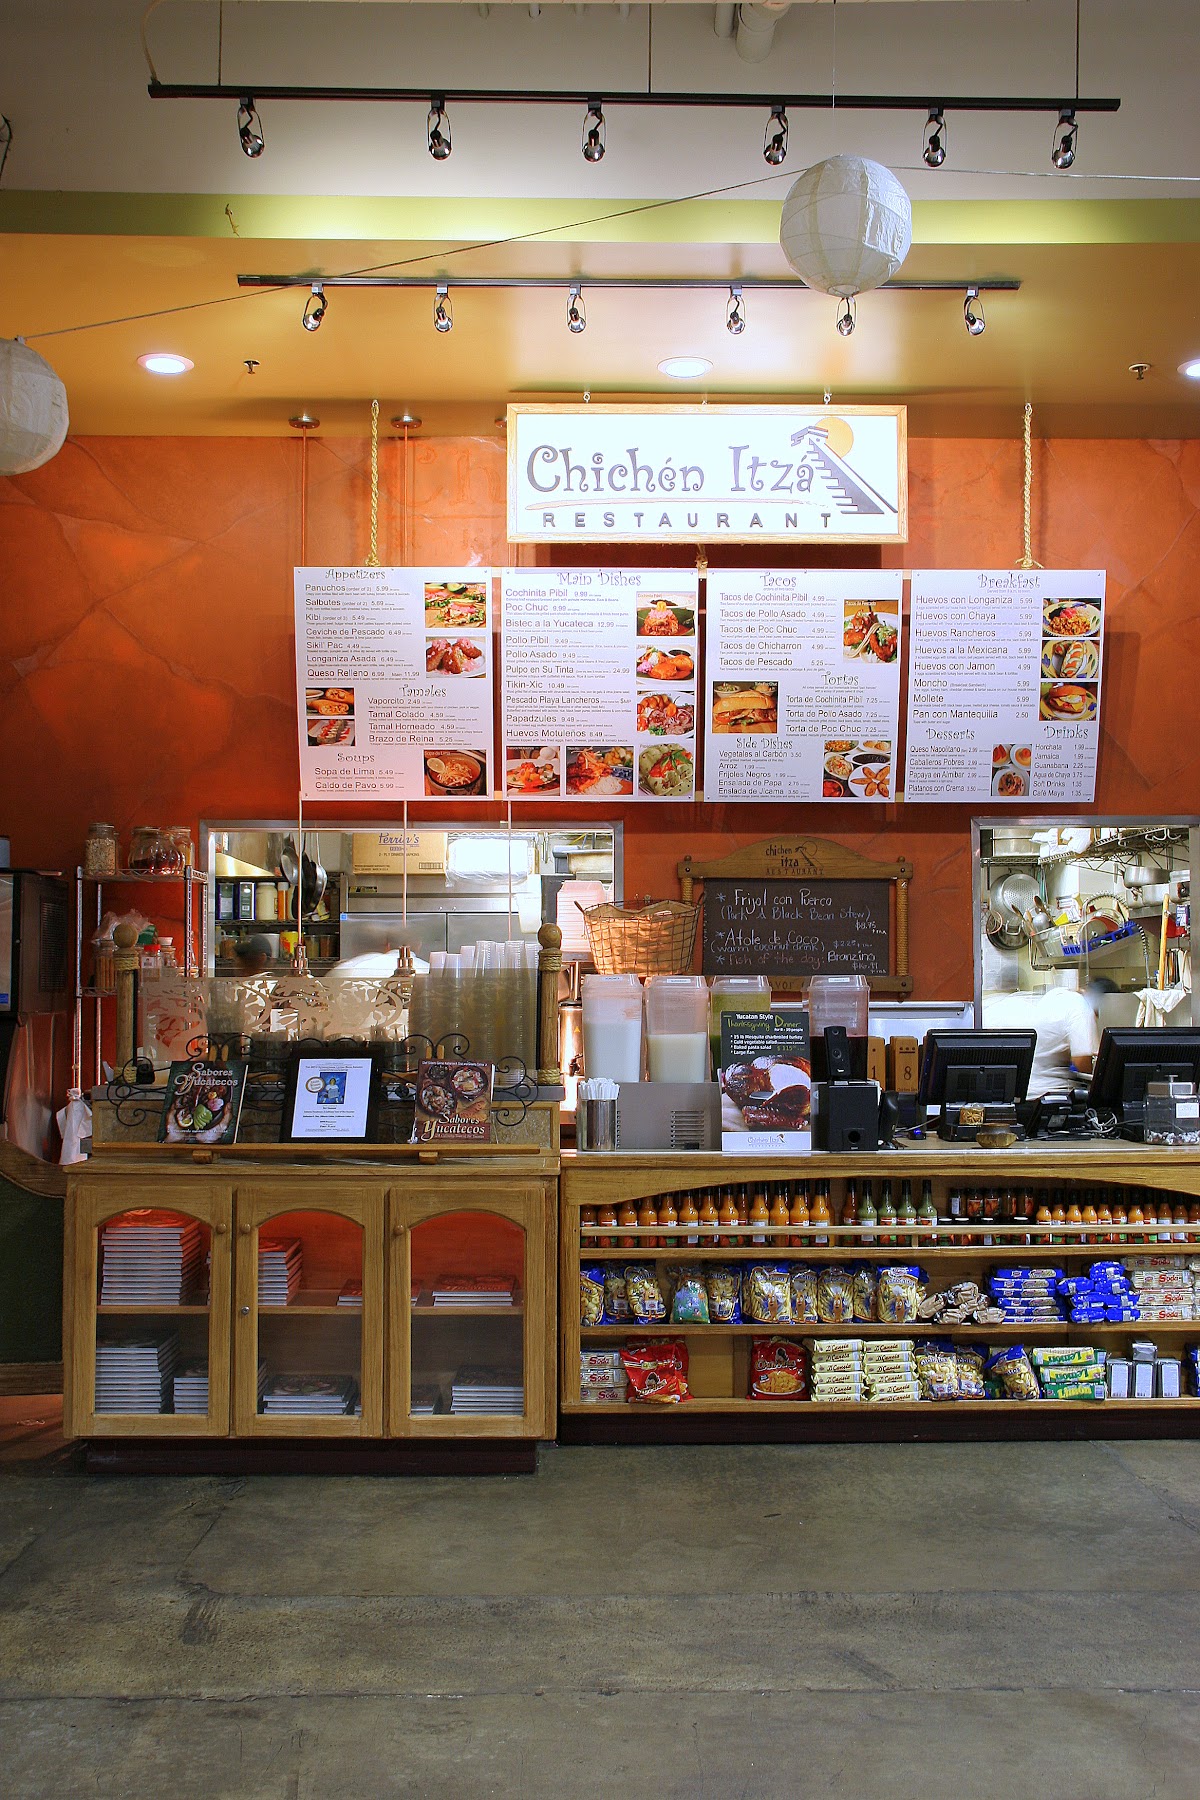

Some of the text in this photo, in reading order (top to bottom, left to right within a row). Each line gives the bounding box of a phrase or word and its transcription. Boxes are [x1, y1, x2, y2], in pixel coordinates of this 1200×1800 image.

[527, 445, 814, 494] Chichén Itzá
[542, 512, 832, 528] RESTAURANT
[325, 569, 386, 581] Appetizers
[557, 572, 640, 586] Main Dishes
[759, 572, 797, 587] Tacos
[978, 573, 1041, 589] Breakfast
[505, 589, 568, 597] Cochinita Pibil
[305, 598, 341, 606] Salbutes
[916, 595, 948, 604] Huevos
[968, 595, 1013, 605] Longaniza
[505, 603, 548, 611] Poc Chuc
[720, 609, 743, 618] Tacos
[745, 609, 756, 618] de
[758, 609, 778, 618] Pollo
[780, 609, 806, 618] Asado
[505, 619, 533, 628] Bistec
[553, 619, 594, 628] Yucateca
[915, 629, 996, 637] Huevos Rancheros
[505, 650, 528, 658] Pollo
[529, 650, 558, 658] Asado
[915, 646, 947, 654] Huevos
[957, 646, 965, 654] la
[968, 646, 1008, 654] Mexicana
[306, 655, 349, 663] Longaniza
[719, 658, 792, 666] Tacos de Pescado
[307, 669, 334, 677] Queso
[505, 666, 528, 674] Pulpo
[821, 671, 859, 686] Tortas
[913, 679, 948, 687] Moncho
[505, 680, 543, 688] Tikin-Xic
[399, 684, 447, 698] Tamales
[368, 697, 404, 705] Vaporcito
[506, 696, 600, 705] Pescado Playa Lancheros
[913, 694, 944, 702] Mollete
[785, 710, 805, 718] Torta
[807, 710, 816, 718] de
[818, 710, 837, 718] Pollo
[839, 710, 862, 718] Asado
[912, 710, 931, 718] Pan
[950, 710, 998, 720] Mantequilla
[506, 715, 557, 724] Papadzules
[926, 728, 975, 740] Desserts
[1044, 724, 1088, 739] Drinks
[369, 735, 434, 743] Brazo de Reina
[736, 737, 793, 750] Side Dishes
[337, 752, 375, 763] Soups
[719, 750, 752, 759] Vegetales
[315, 767, 375, 776] Sopa de Lima
[766, 844, 792, 856] chichen
[781, 856, 799, 866] itza
[774, 895, 792, 905] con
[800, 888, 833, 907] Puerco
[772, 907, 803, 920] Black
[810, 908, 834, 920] Bean
[725, 928, 819, 946] Atole de Coco
[754, 940, 789, 951] coconut
[728, 954, 752, 965] Fish
[758, 953, 769, 964] of
[776, 952, 794, 964] the
[828, 950, 876, 962] Branzino
[723, 1015, 801, 1032] Thanksgiving Dinner
[192, 1062, 233, 1079] Sabores
[872, 1066, 877, 1079] 1
[904, 1066, 911, 1080] 8
[174, 1073, 238, 1096] Yucatecos
[438, 1113, 480, 1124] Sabores
[421, 1120, 485, 1142] Yucatecos
[1158, 1273, 1179, 1283] Soda
[1164, 1294, 1184, 1302] Soda
[1158, 1309, 1179, 1319] Soda
[589, 1356, 610, 1365] Soda
[589, 1374, 610, 1382] Soda
[598, 1391, 619, 1399] Soda
[1057, 1383, 1092, 1399] Limón
